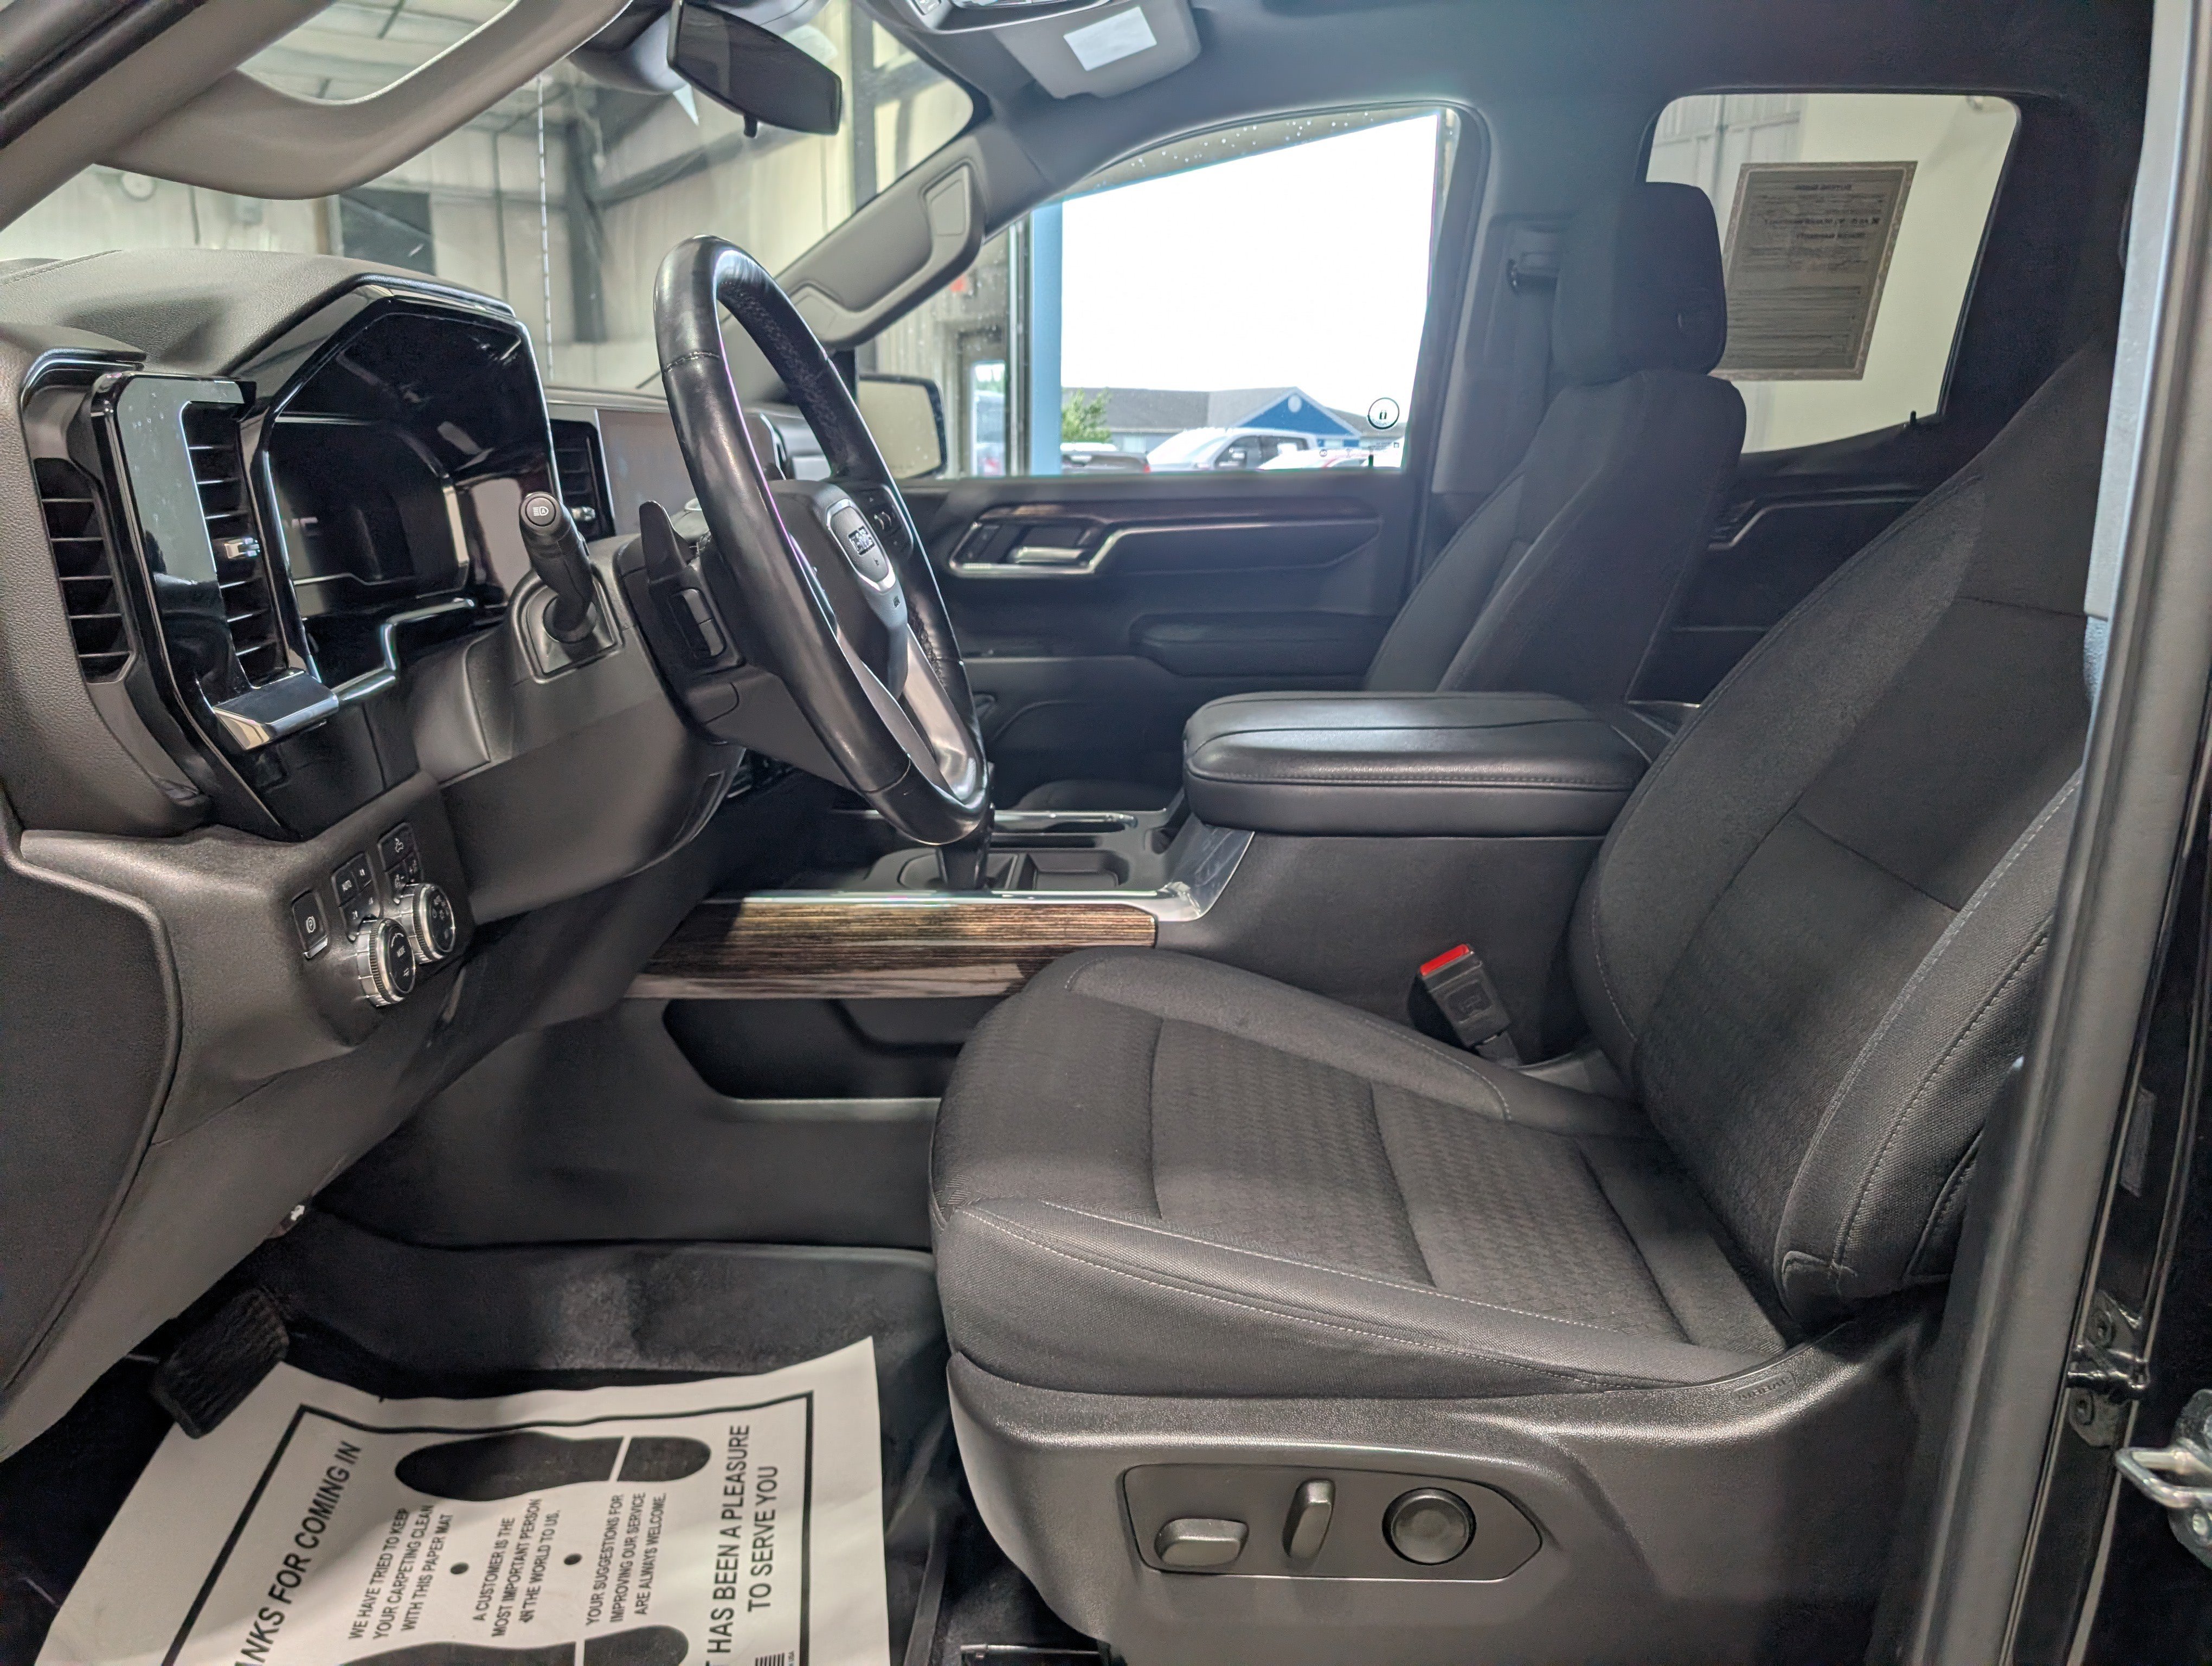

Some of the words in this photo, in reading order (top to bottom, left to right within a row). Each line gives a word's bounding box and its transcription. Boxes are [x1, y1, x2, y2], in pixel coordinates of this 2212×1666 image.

[721, 1425, 750, 1520] PLEASURE
[755, 1466, 779, 1506] YOU
[519, 1498, 543, 1540] PERSON
[608, 1494, 625, 1515] FOR
[389, 1508, 409, 1535] KEEP
[435, 1514, 454, 1534] MAT
[498, 1517, 515, 1537] THE
[540, 1528, 556, 1544] TO
[719, 1524, 742, 1539] A
[235, 1606, 285, 1666] NKS
[268, 1552, 312, 1605] FOR
[294, 1465, 351, 1549] COMING
[334, 1440, 362, 1465] IN
[382, 1536, 400, 1551] TO
[422, 1536, 447, 1572] PAPER
[494, 1539, 509, 1550] IS
[593, 1516, 620, 1590] SUGGESTIONS
[621, 1535, 638, 1559] OUR
[750, 1509, 776, 1577] SERVE
[369, 1553, 394, 1585] TRIED
[373, 1606, 400, 1640] YOUR
[387, 1540, 421, 1604] CARPETING
[411, 1504, 434, 1539] CLEAN
[501, 1542, 530, 1602] IMPORTANT
[529, 1544, 551, 1584] WORLD
[638, 1547, 658, 1590] ALWAYS
[712, 1544, 741, 1600] BEEN
[411, 1574, 434, 1599] THIS
[475, 1550, 506, 1611] CUSTOMER
[609, 1560, 634, 1623] IMPROVING
[357, 1587, 381, 1617] HAVE
[522, 1585, 541, 1609] THE
[586, 1591, 606, 1626] YOUR
[634, 1591, 651, 1616] ARE
[747, 1582, 773, 1613] TO
[348, 1620, 369, 1640] WE
[401, 1601, 424, 1631] WITH
[473, 1612, 487, 1622] A
[491, 1605, 513, 1637] MOST
[706, 1607, 735, 1654] HAS
